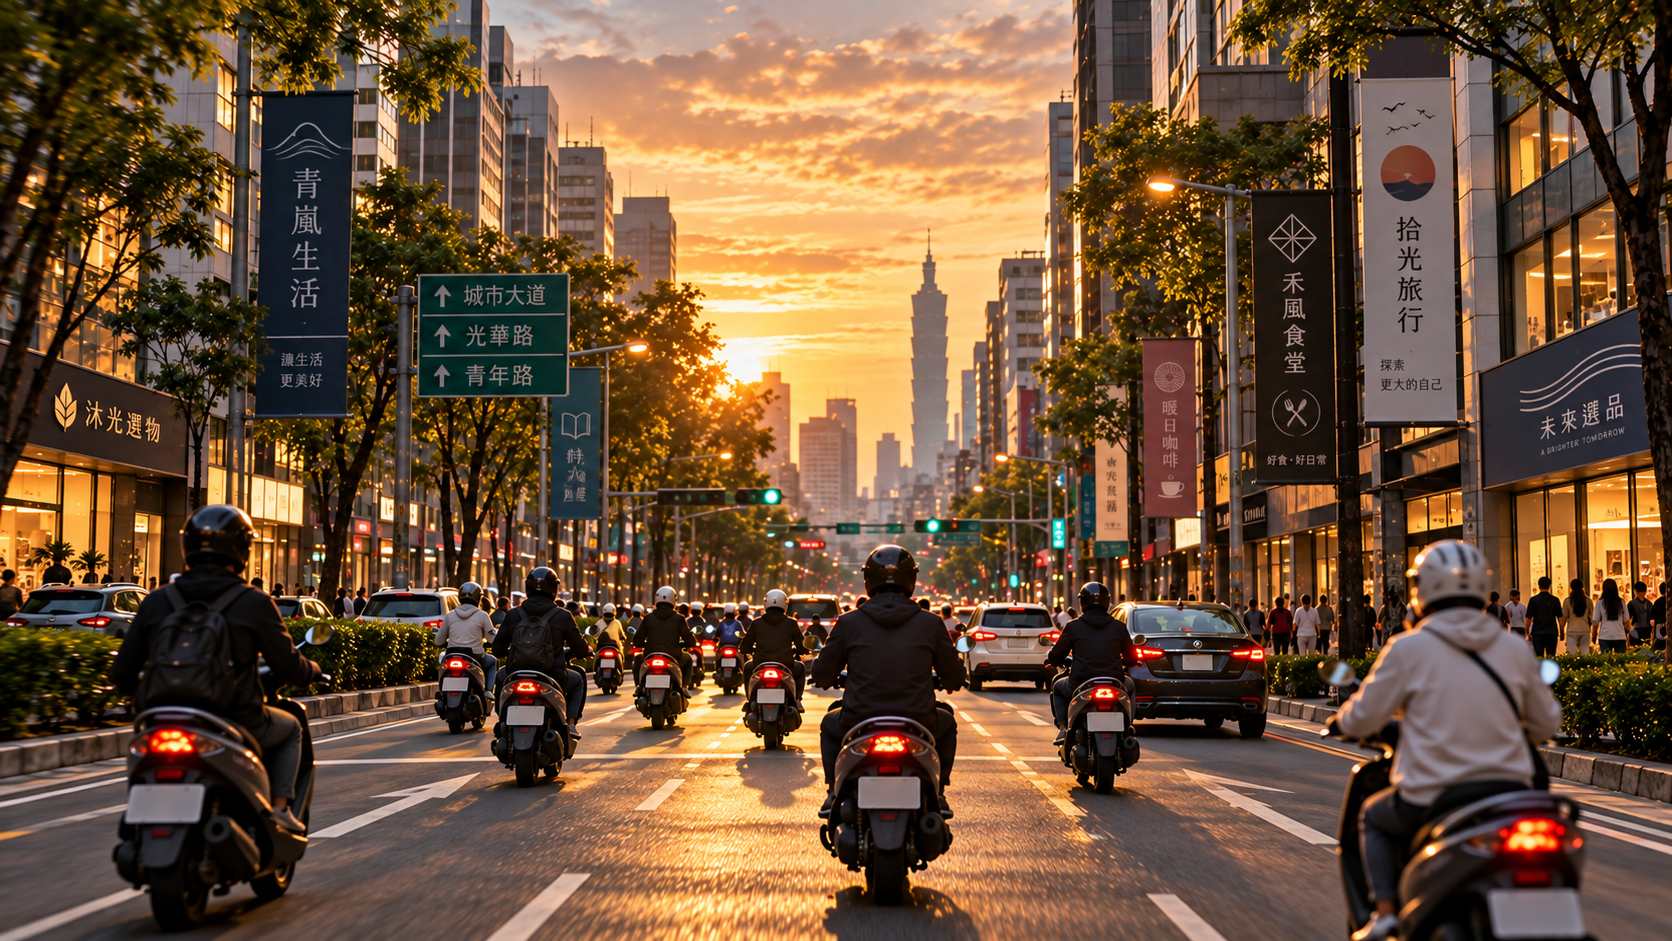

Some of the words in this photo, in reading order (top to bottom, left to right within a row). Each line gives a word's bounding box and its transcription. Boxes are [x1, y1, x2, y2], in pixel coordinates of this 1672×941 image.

[291, 168, 322, 308] 青嵐生活
[1396, 216, 1423, 333] 拾光旅行
[464, 284, 546, 307] 城市大道
[1282, 272, 1306, 374] 禾風食堂
[466, 324, 534, 347] 光華路
[280, 373, 323, 388] 更美好
[465, 364, 534, 387] 青年路
[1381, 378, 1442, 391] 更大的自己
[85, 400, 161, 443] 沐光選物
[1540, 393, 1624, 440] 未來選品
[1582, 426, 1625, 444] TOMORROW
